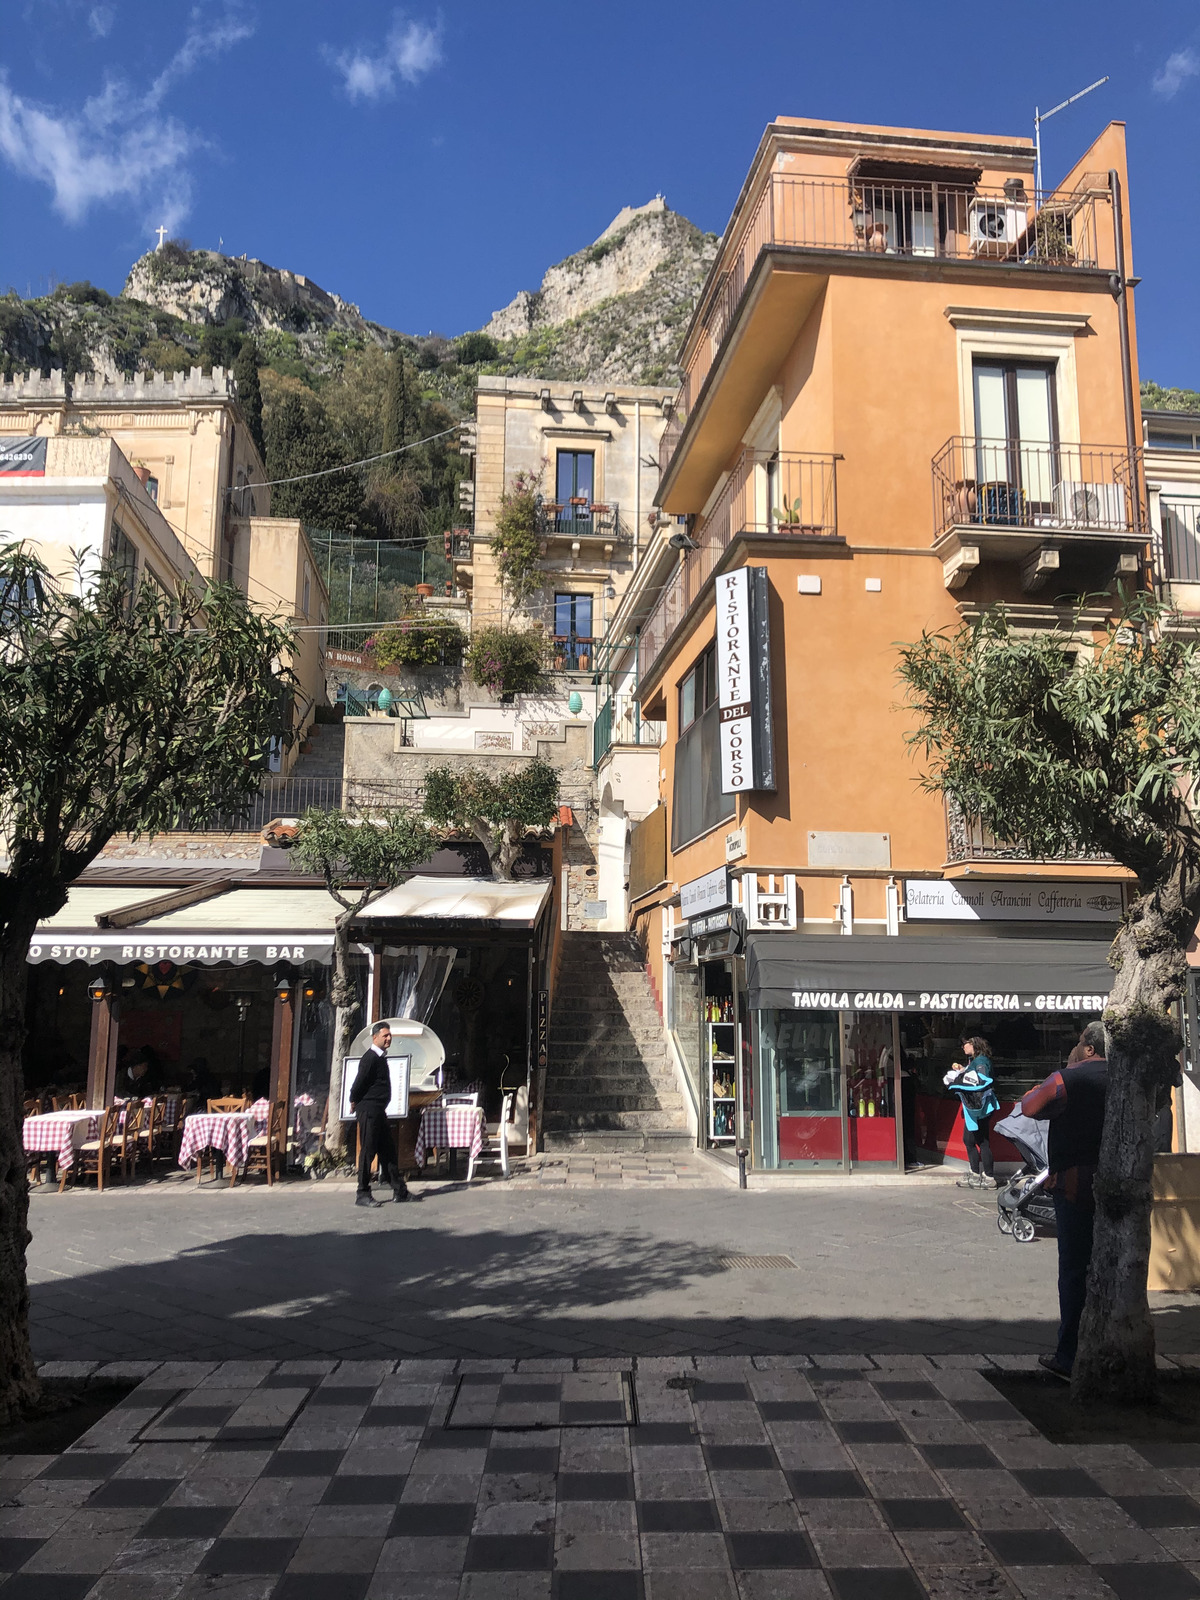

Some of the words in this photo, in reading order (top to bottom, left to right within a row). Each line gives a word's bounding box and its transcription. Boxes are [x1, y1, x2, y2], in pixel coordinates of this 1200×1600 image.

[725, 576, 741, 701] RISTORANTE
[723, 706, 748, 720] DEL
[730, 723, 744, 787] CORSO
[907, 888, 945, 906] Gelateria
[951, 889, 984, 906] Cannoli
[990, 889, 1032, 907] Arancini
[1037, 890, 1082, 914] Caffetteria
[50, 945, 101, 958] STOP
[121, 945, 249, 959] RISTORANTE
[265, 946, 305, 959] BAR
[792, 992, 850, 1008] TAVOLA
[854, 992, 904, 1009] CALDA
[919, 993, 1020, 1010] PASTICCERIA
[539, 993, 547, 1053] PIZZA
